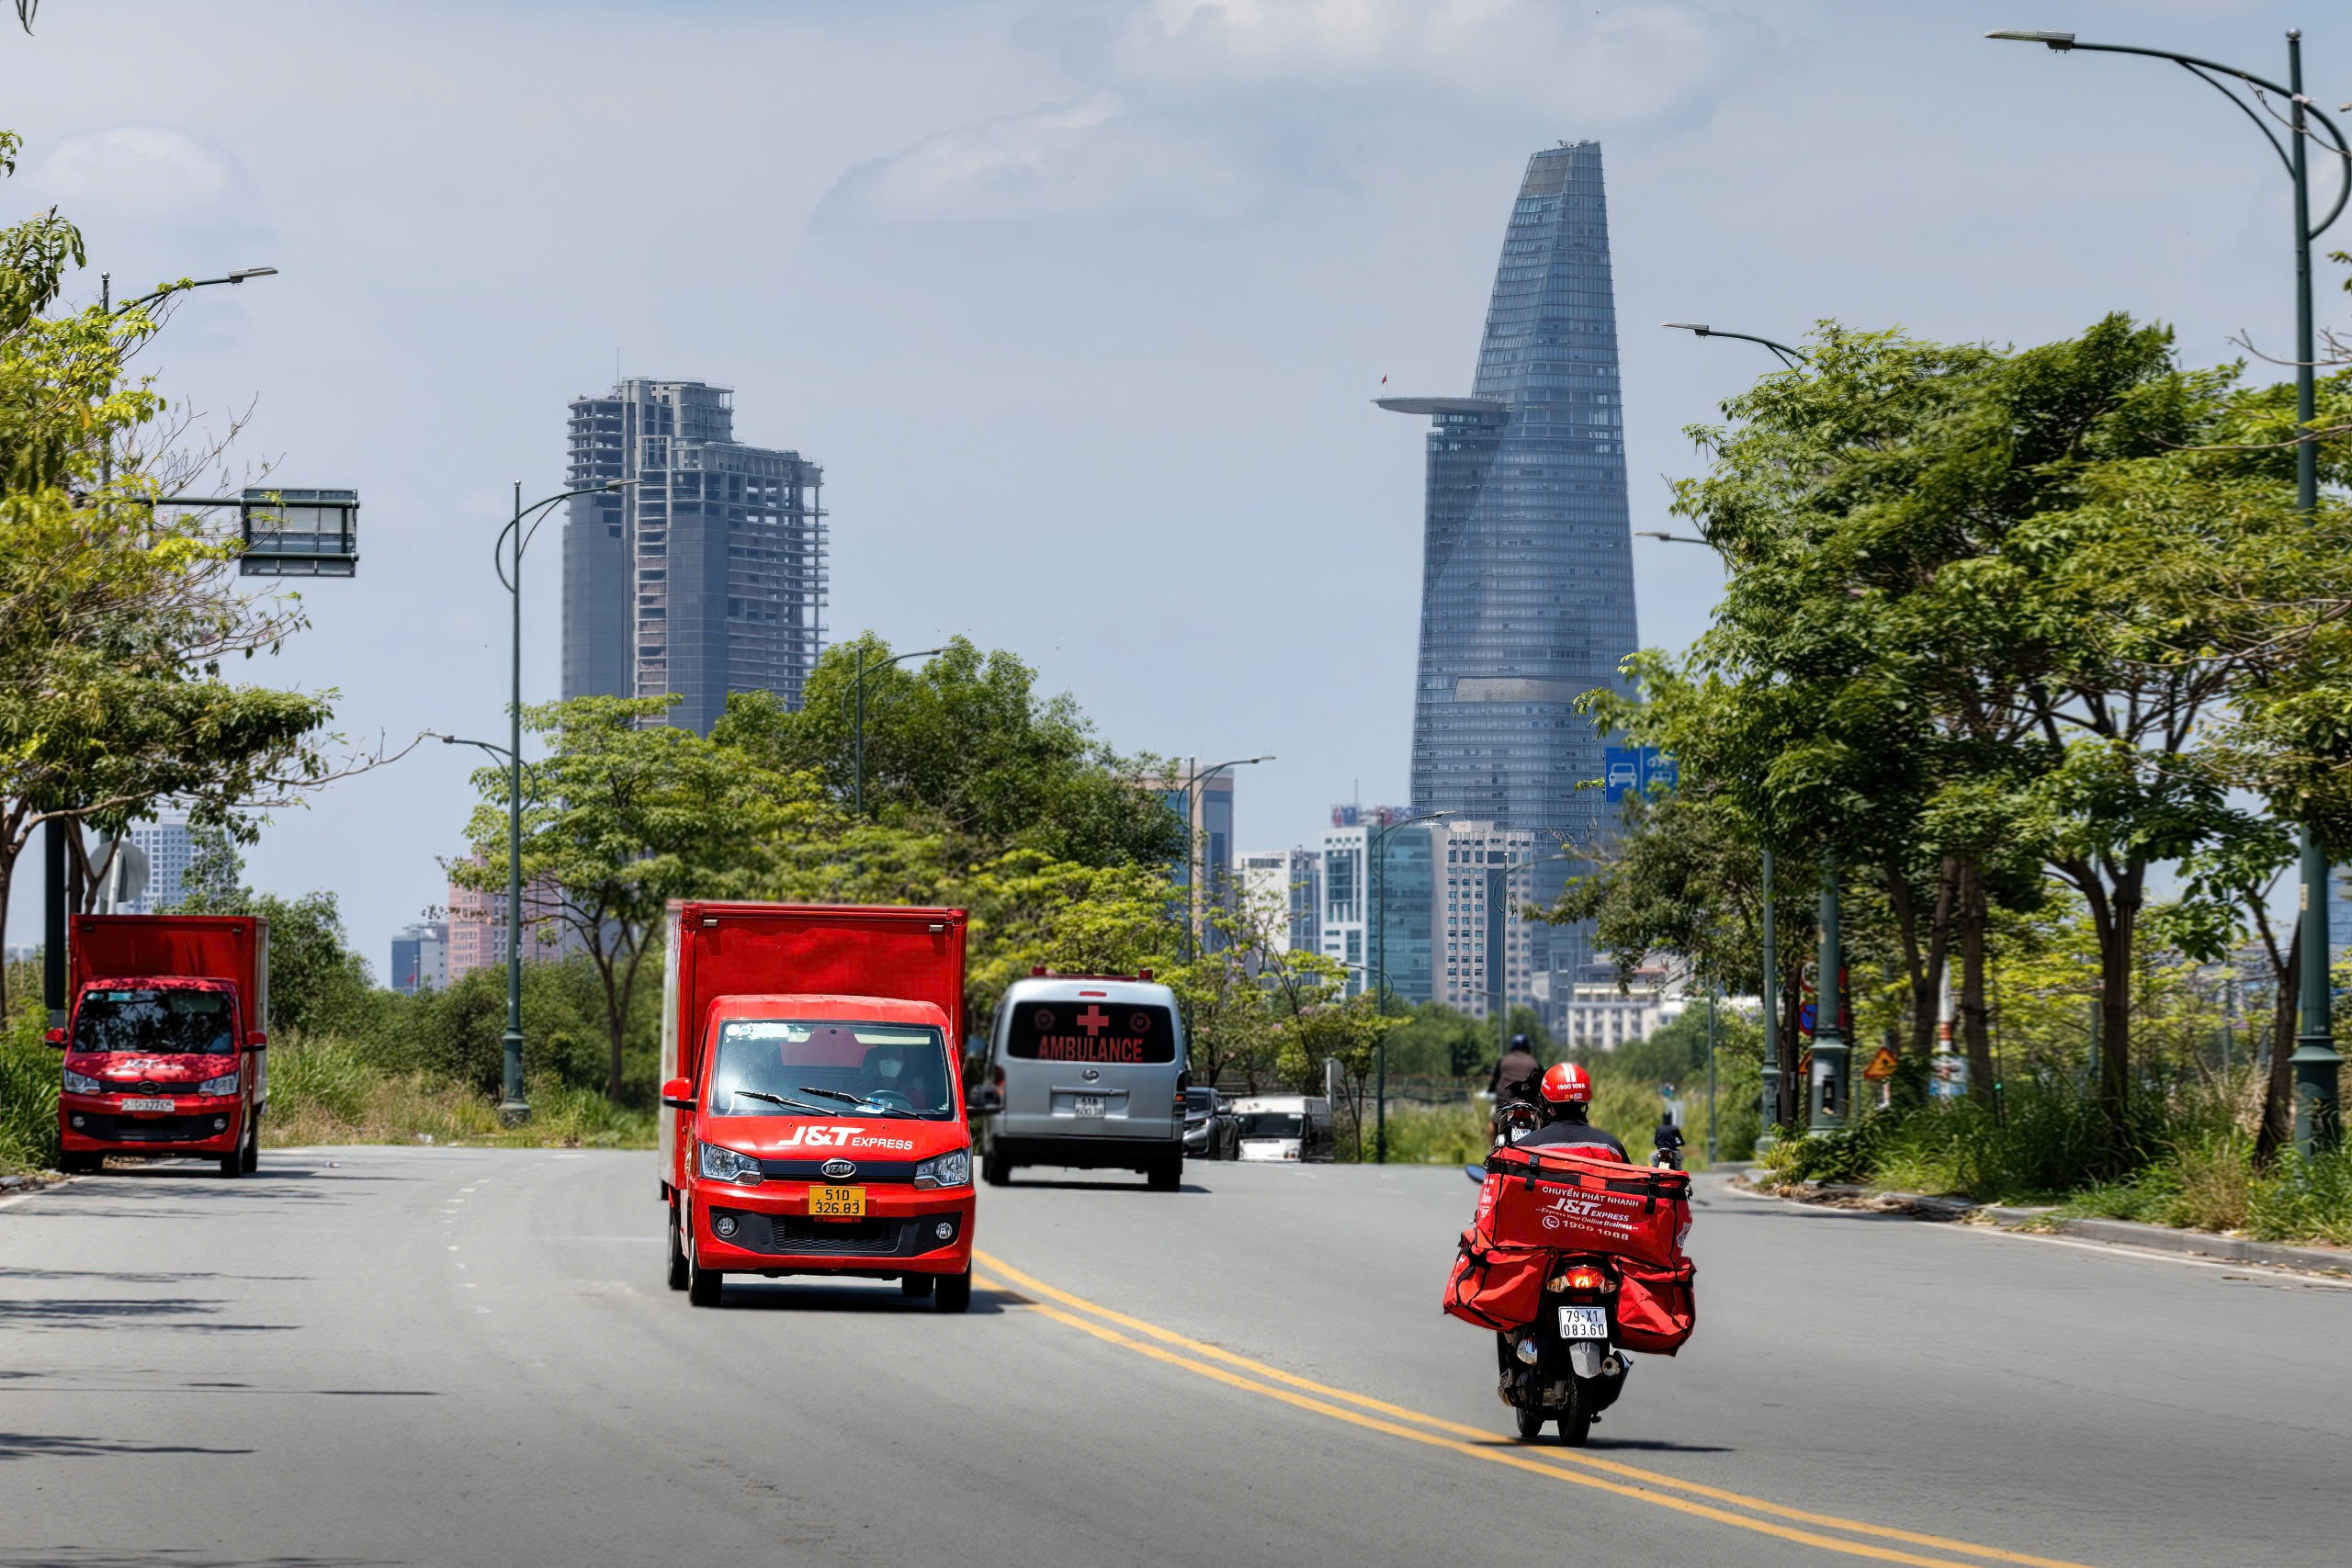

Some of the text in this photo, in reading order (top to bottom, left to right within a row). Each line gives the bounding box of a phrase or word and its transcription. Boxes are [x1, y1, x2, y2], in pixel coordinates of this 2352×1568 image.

[1038, 1035, 1144, 1063] AMBULANCE
[776, 1126, 913, 1150] J&T EXPRESS
[825, 1164, 853, 1174] VEAM
[825, 1190, 850, 1201] 51D
[1582, 1192, 1605, 1201] PHÁT
[1608, 1197, 1639, 1207] NHANH
[815, 1202, 860, 1214] 326.83
[1547, 1198, 1629, 1222] J&T EXPRESS
[1582, 1217, 1603, 1225] Online
[1603, 1221, 1632, 1230] Business
[1563, 1220, 1629, 1241] 1900 1088
[1566, 1310, 1598, 1323] 79-X1
[1564, 1324, 1604, 1336] 083.60
